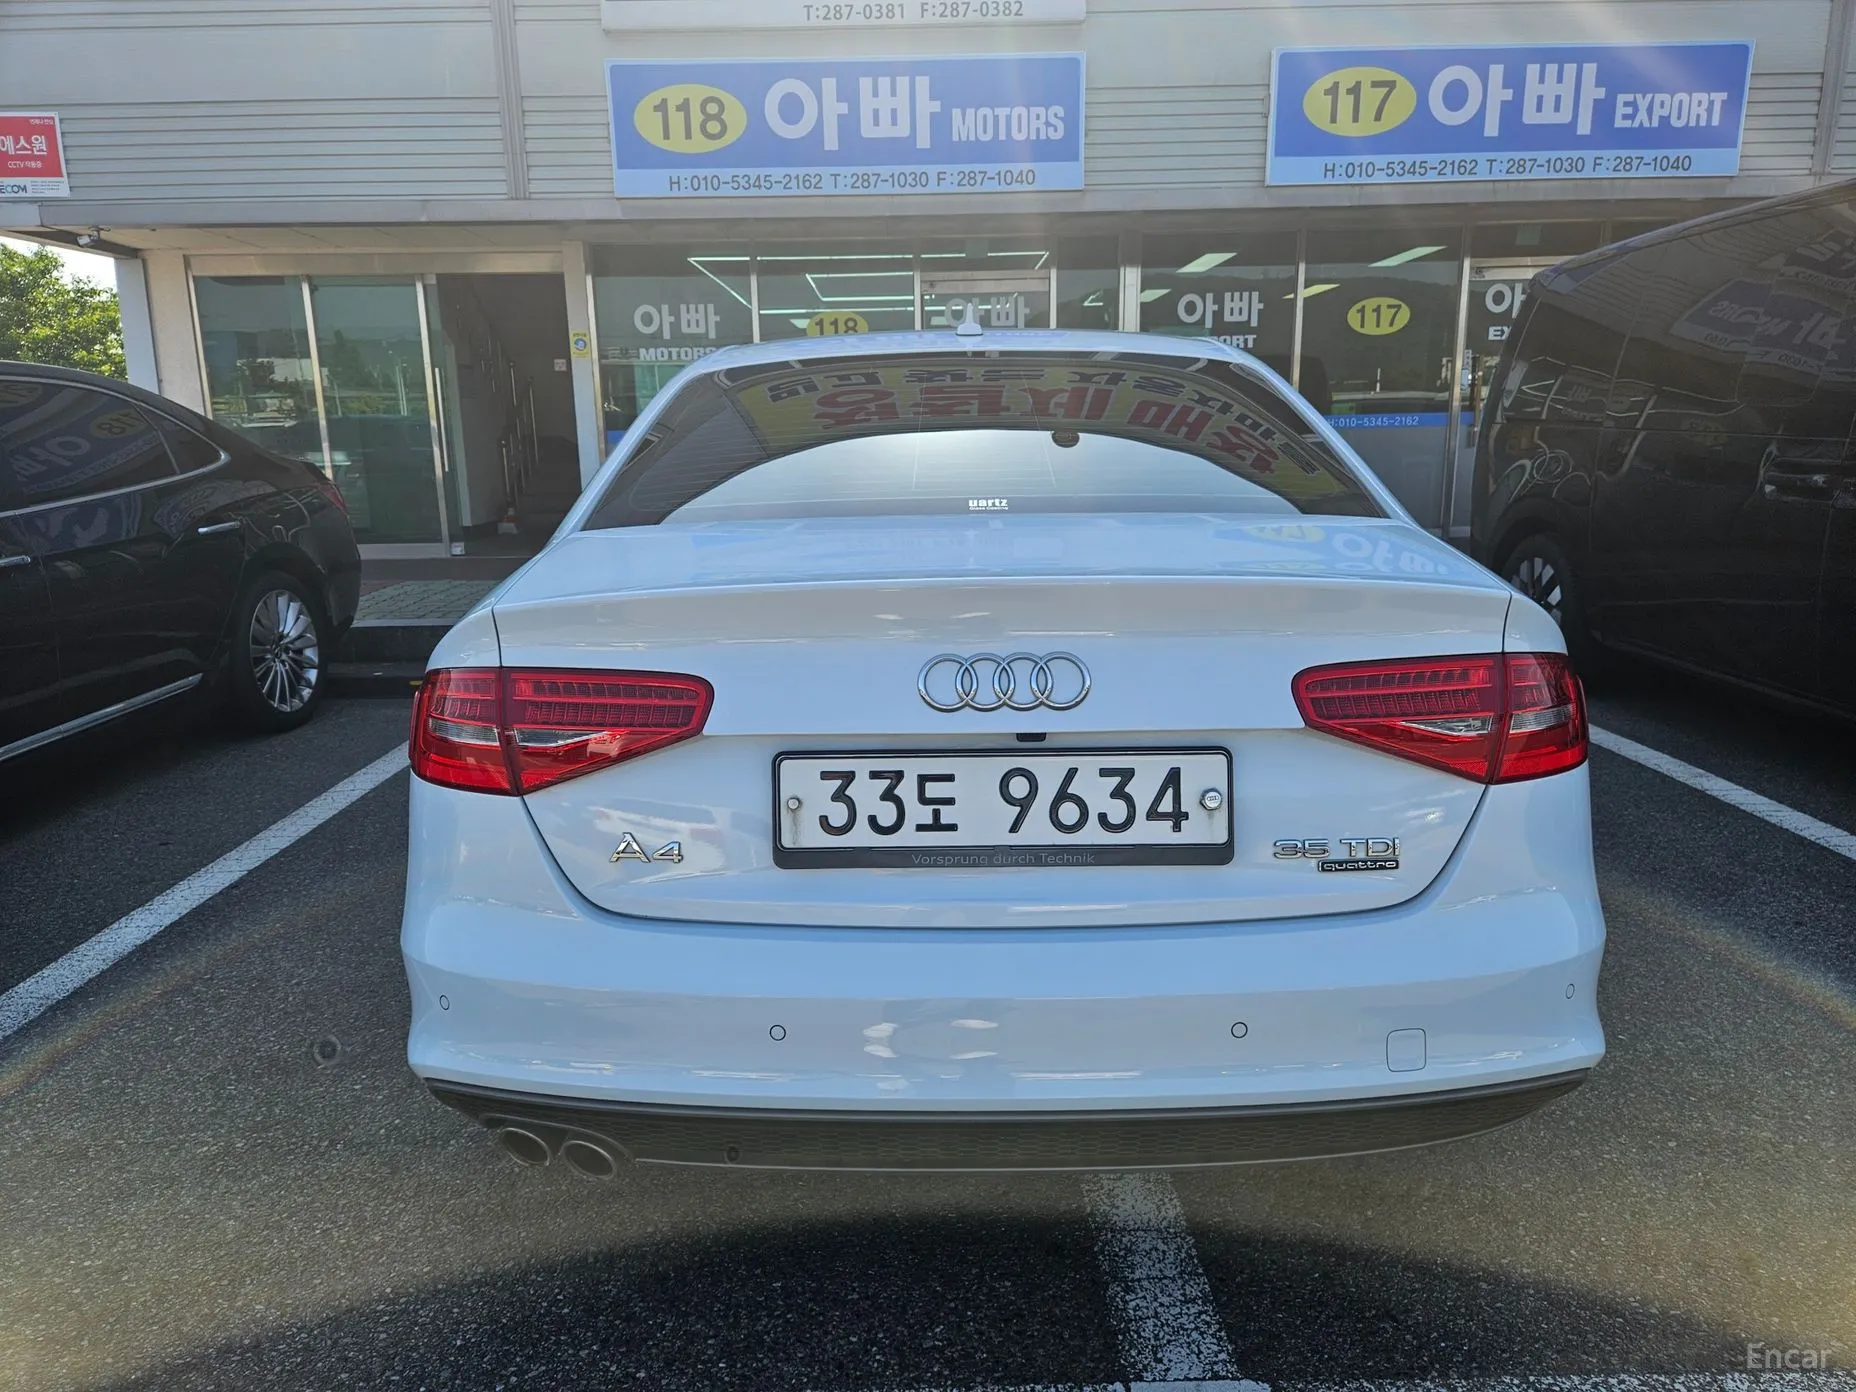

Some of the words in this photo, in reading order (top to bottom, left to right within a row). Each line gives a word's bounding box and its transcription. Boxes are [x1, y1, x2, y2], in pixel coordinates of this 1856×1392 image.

[803, 4, 905, 21] T:287-0381
[920, 1, 1024, 19] F:287-0382
[1323, 80, 1397, 125] 117
[1428, 62, 1606, 137] 아빠
[1613, 92, 1728, 129] EXPORT
[653, 95, 729, 141] 118
[764, 75, 941, 151] 아빠
[952, 105, 1065, 142] MOTORS
[0, 134, 48, 155] 에스원
[8, 160, 24, 169] CCTV
[1324, 158, 1478, 179] H:010-5345-2162
[1486, 156, 1585, 175] T:287-1030
[1592, 154, 1692, 173] F:287-1040
[0, 184, 28, 194] ECOM
[669, 175, 823, 192] H:010-5345-2162
[830, 171, 929, 189] T:287-1030
[936, 168, 1036, 187] F:287-1040
[945, 295, 1030, 328] 아빠
[1177, 291, 1264, 328] 아빠
[1485, 283, 1526, 319] 아
[633, 303, 720, 340] 아빠
[814, 316, 859, 336] 118
[1356, 303, 1402, 328] 117
[819, 769, 959, 836] 33도
[999, 766, 1190, 834] 9634
[609, 831, 684, 864] A4
[911, 853, 988, 866] Vorsprung
[993, 853, 1035, 864] durch
[1039, 852, 1096, 864] Technik
[1273, 837, 1331, 859] 35
[1340, 836, 1401, 858] TDI
[1323, 861, 1398, 872] quattro
